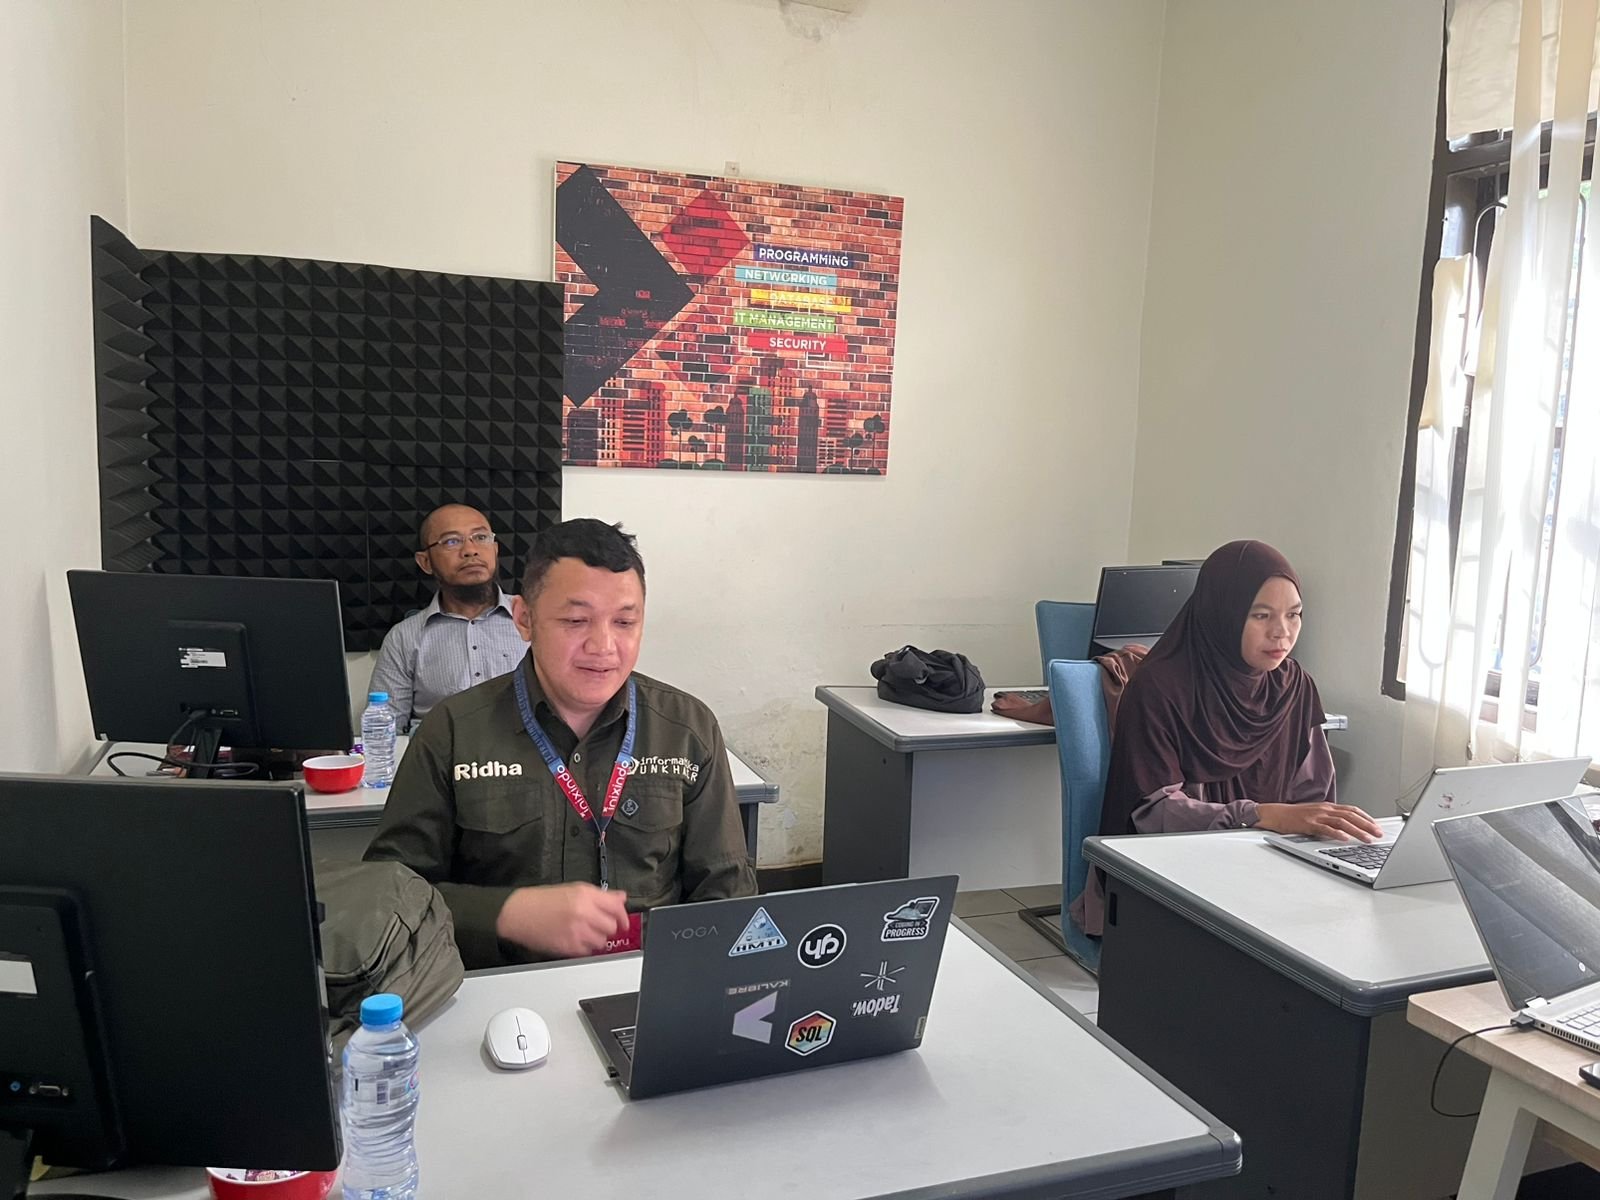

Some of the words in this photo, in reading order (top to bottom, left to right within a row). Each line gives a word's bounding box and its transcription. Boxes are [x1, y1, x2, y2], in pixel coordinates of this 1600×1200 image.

[758, 247, 849, 267] PROGRAMMING
[744, 269, 828, 286] NETWORKING
[735, 312, 746, 323] IT
[749, 313, 834, 330] MANAGEMENT
[769, 337, 827, 351] SECURITY
[454, 761, 522, 780] Ridha
[557, 764, 590, 817] inixindo
[603, 760, 629, 812] inixindo
[671, 925, 719, 940] YOGA
[885, 927, 925, 938] PROGRESS
[736, 938, 780, 952] HMTI
[728, 979, 789, 995] KALIBRE
[852, 994, 901, 1017] Tadow.
[796, 1025, 822, 1043] SQL
